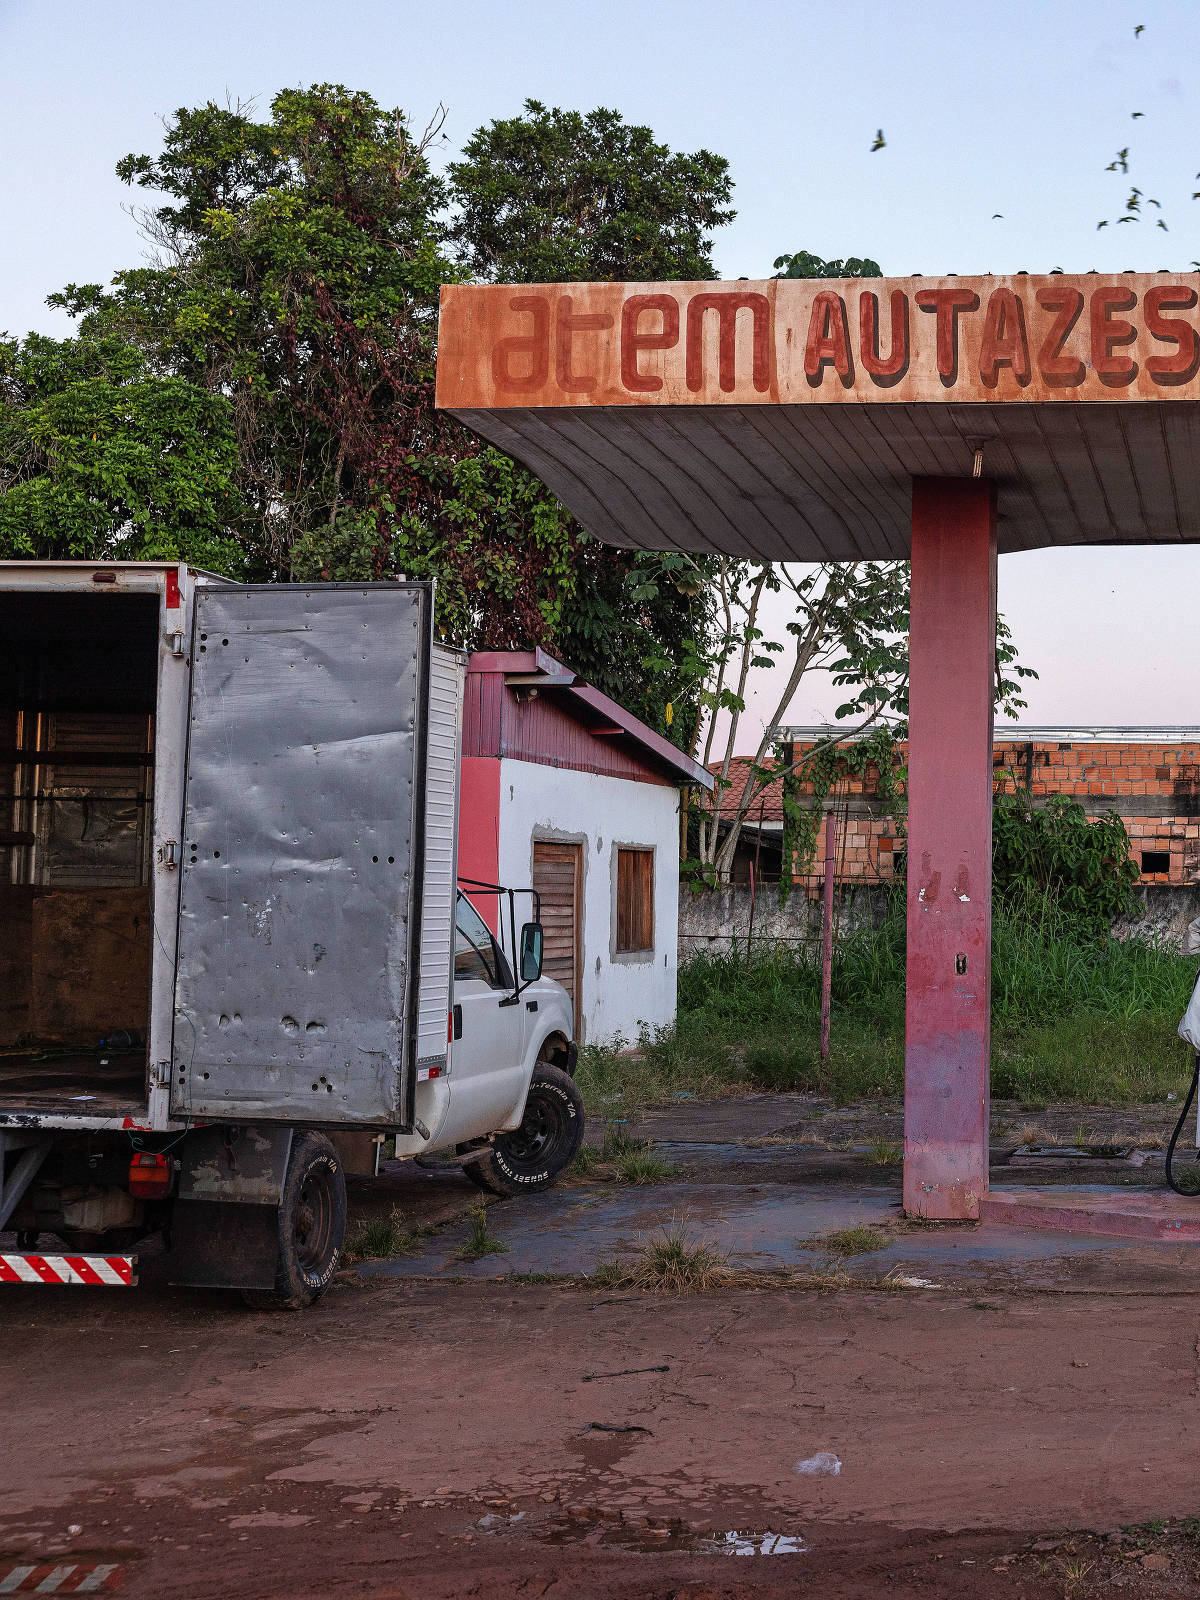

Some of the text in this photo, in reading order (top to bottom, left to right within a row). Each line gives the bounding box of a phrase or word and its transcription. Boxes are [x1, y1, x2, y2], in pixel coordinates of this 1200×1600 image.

[491, 292, 771, 395] atem
[803, 286, 1200, 389] AUTAZES
[529, 1081, 568, 1101] ll-Terrain
[495, 1151, 549, 1183] SUNSET TIRES
